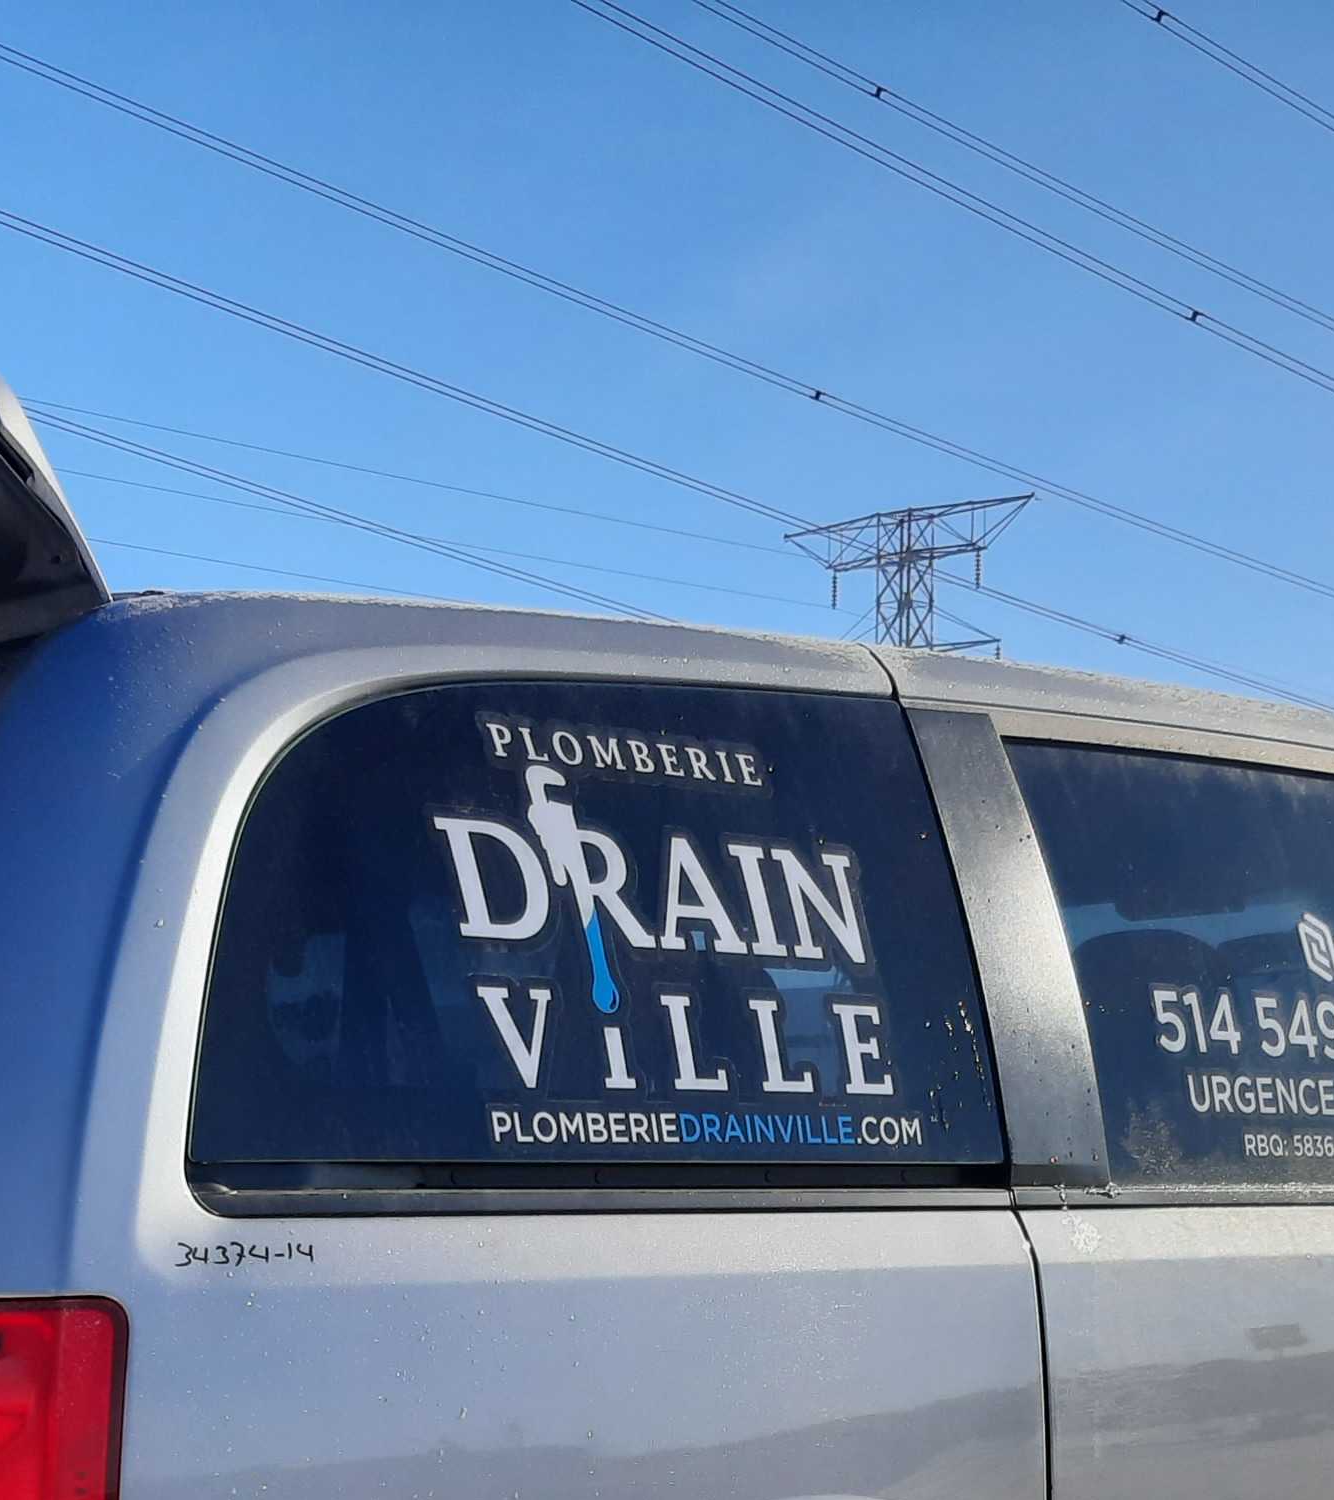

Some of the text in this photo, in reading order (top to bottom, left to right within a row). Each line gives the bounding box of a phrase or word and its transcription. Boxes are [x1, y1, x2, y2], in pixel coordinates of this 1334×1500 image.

[486, 722, 763, 787] PLOMBERIE
[433, 815, 867, 965] DRAIN
[1151, 989, 1242, 1056] 514
[490, 1110, 923, 1147] PLOMBERIEDRAINVILLE.COM
[1243, 1134, 1289, 1157] RBQ:
